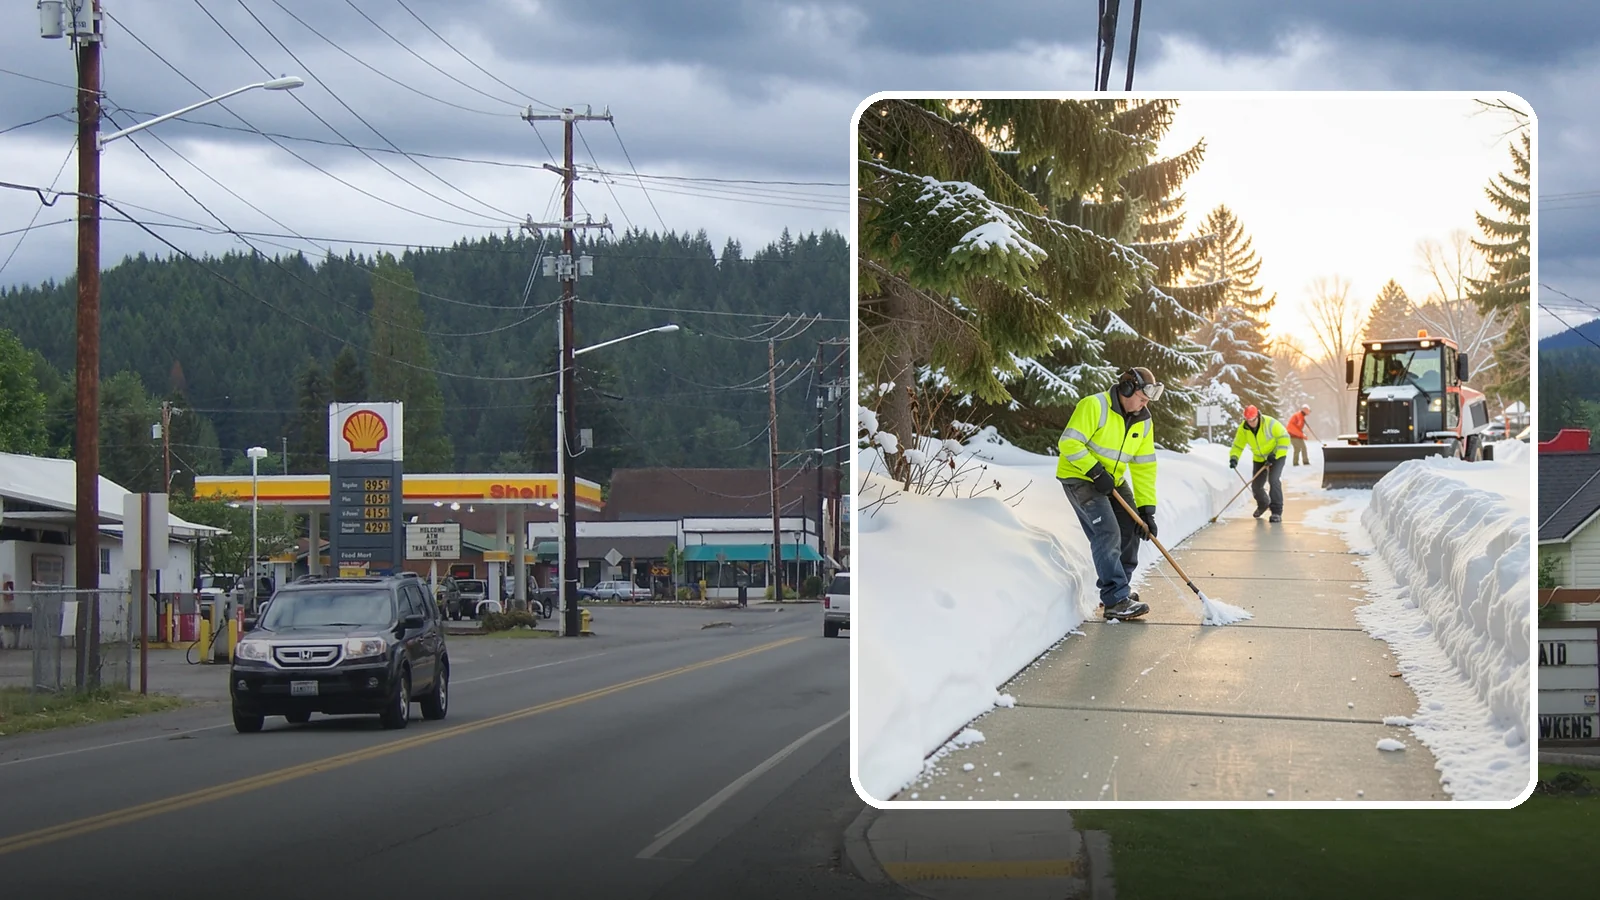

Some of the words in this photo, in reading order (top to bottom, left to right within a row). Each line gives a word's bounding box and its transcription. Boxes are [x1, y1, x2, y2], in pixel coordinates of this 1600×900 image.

[365, 480, 383, 491] 395
[490, 484, 547, 499] Shell
[365, 494, 383, 504] 405
[365, 508, 383, 518] 415
[366, 522, 383, 532] 429
[1539, 643, 1566, 665] AID
